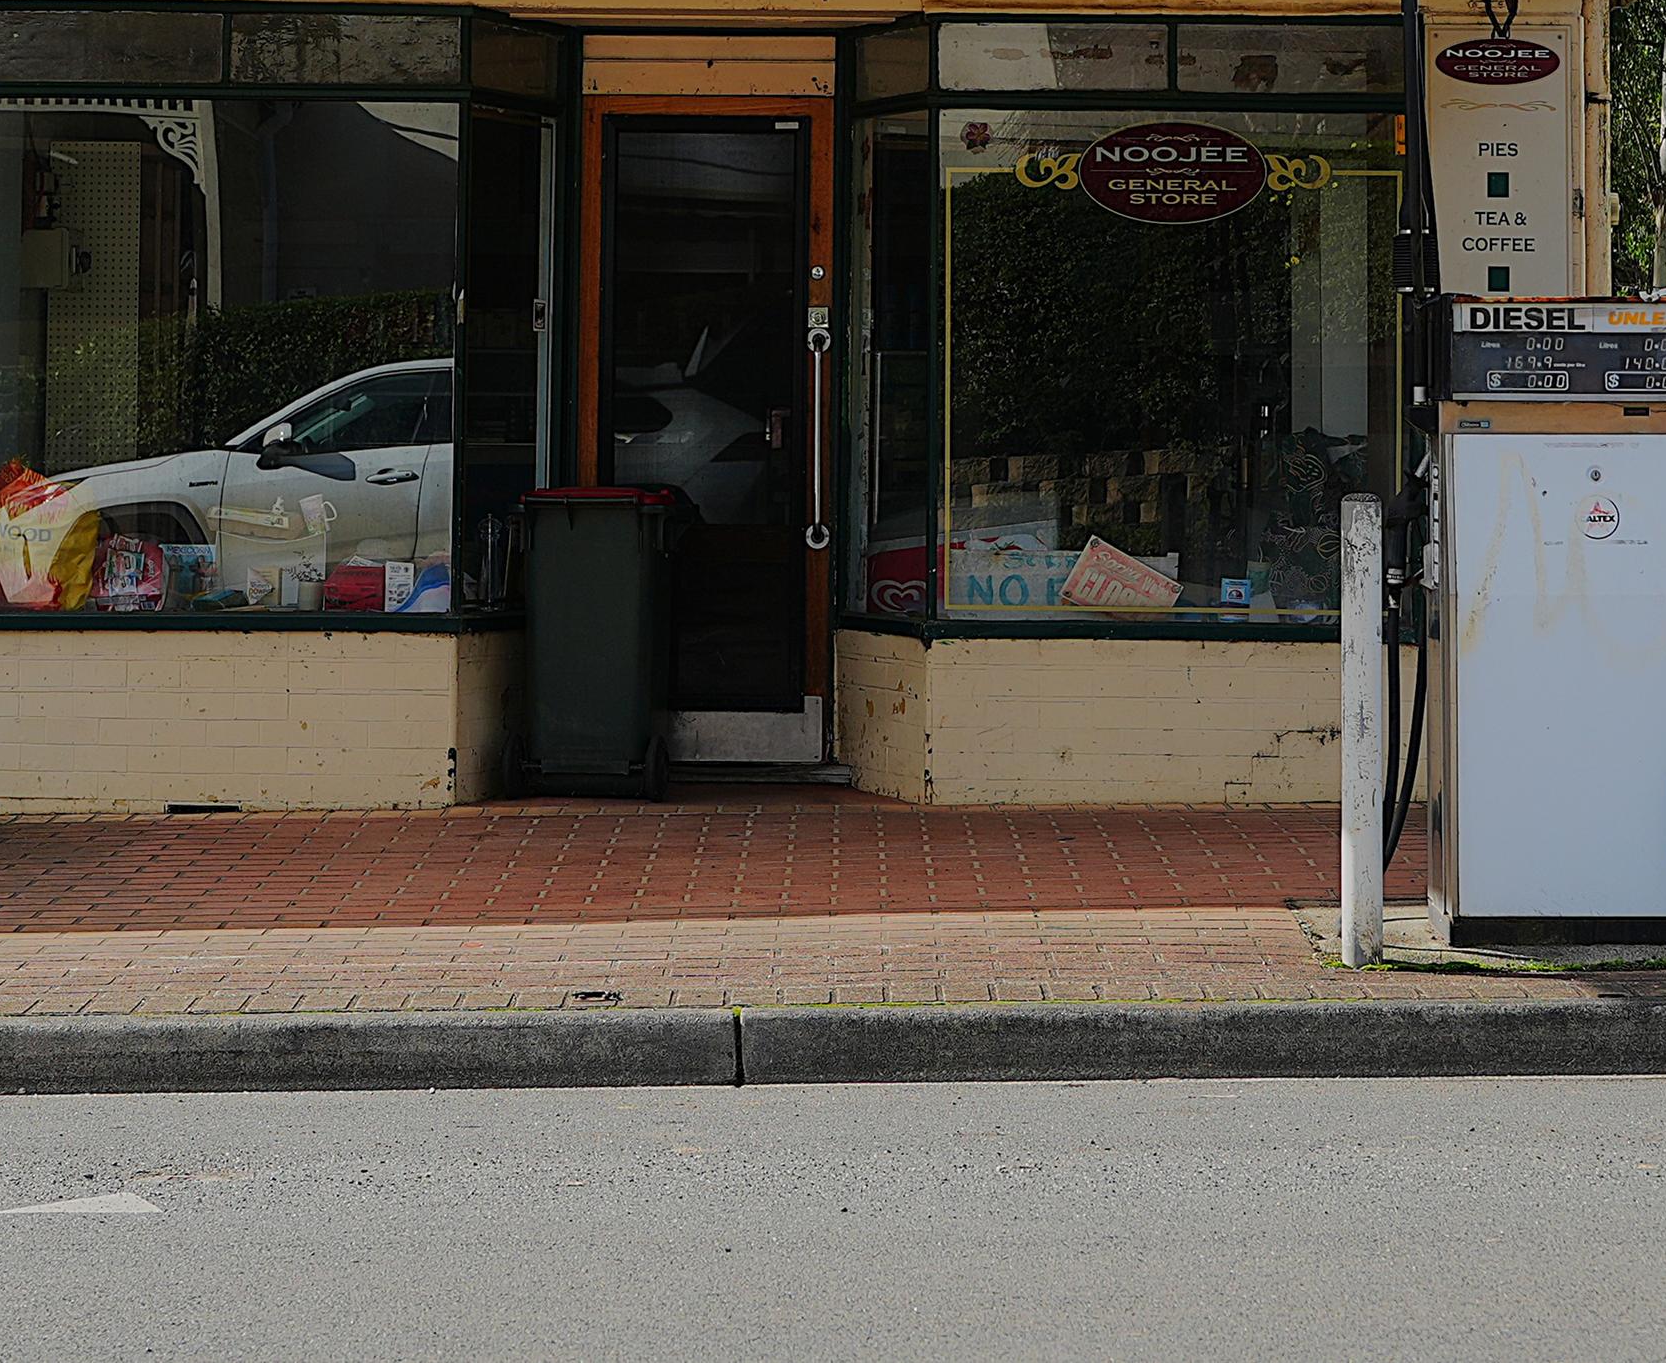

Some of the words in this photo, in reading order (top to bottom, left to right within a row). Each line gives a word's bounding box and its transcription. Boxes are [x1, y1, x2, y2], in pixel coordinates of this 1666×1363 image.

[1446, 49, 1550, 58] NOOJEE
[1454, 64, 1542, 72] GENERAL
[1095, 146, 1249, 164] NOOJEE
[1478, 143, 1519, 157] PIES
[1108, 179, 1237, 192] GENERAL
[1129, 192, 1217, 205] STORE
[1474, 211, 1511, 226] TEA
[1514, 211, 1527, 226] &
[1462, 237, 1535, 252] COFFEE
[1470, 307, 1585, 330] DIESEL
[1526, 337, 1564, 351] 0.00
[1490, 373, 1501, 388] $
[1527, 375, 1565, 388] 0.00
[1608, 374, 1620, 388] $
[1582, 515, 1616, 523] ALTEX
[967, 574, 1029, 605] NO
